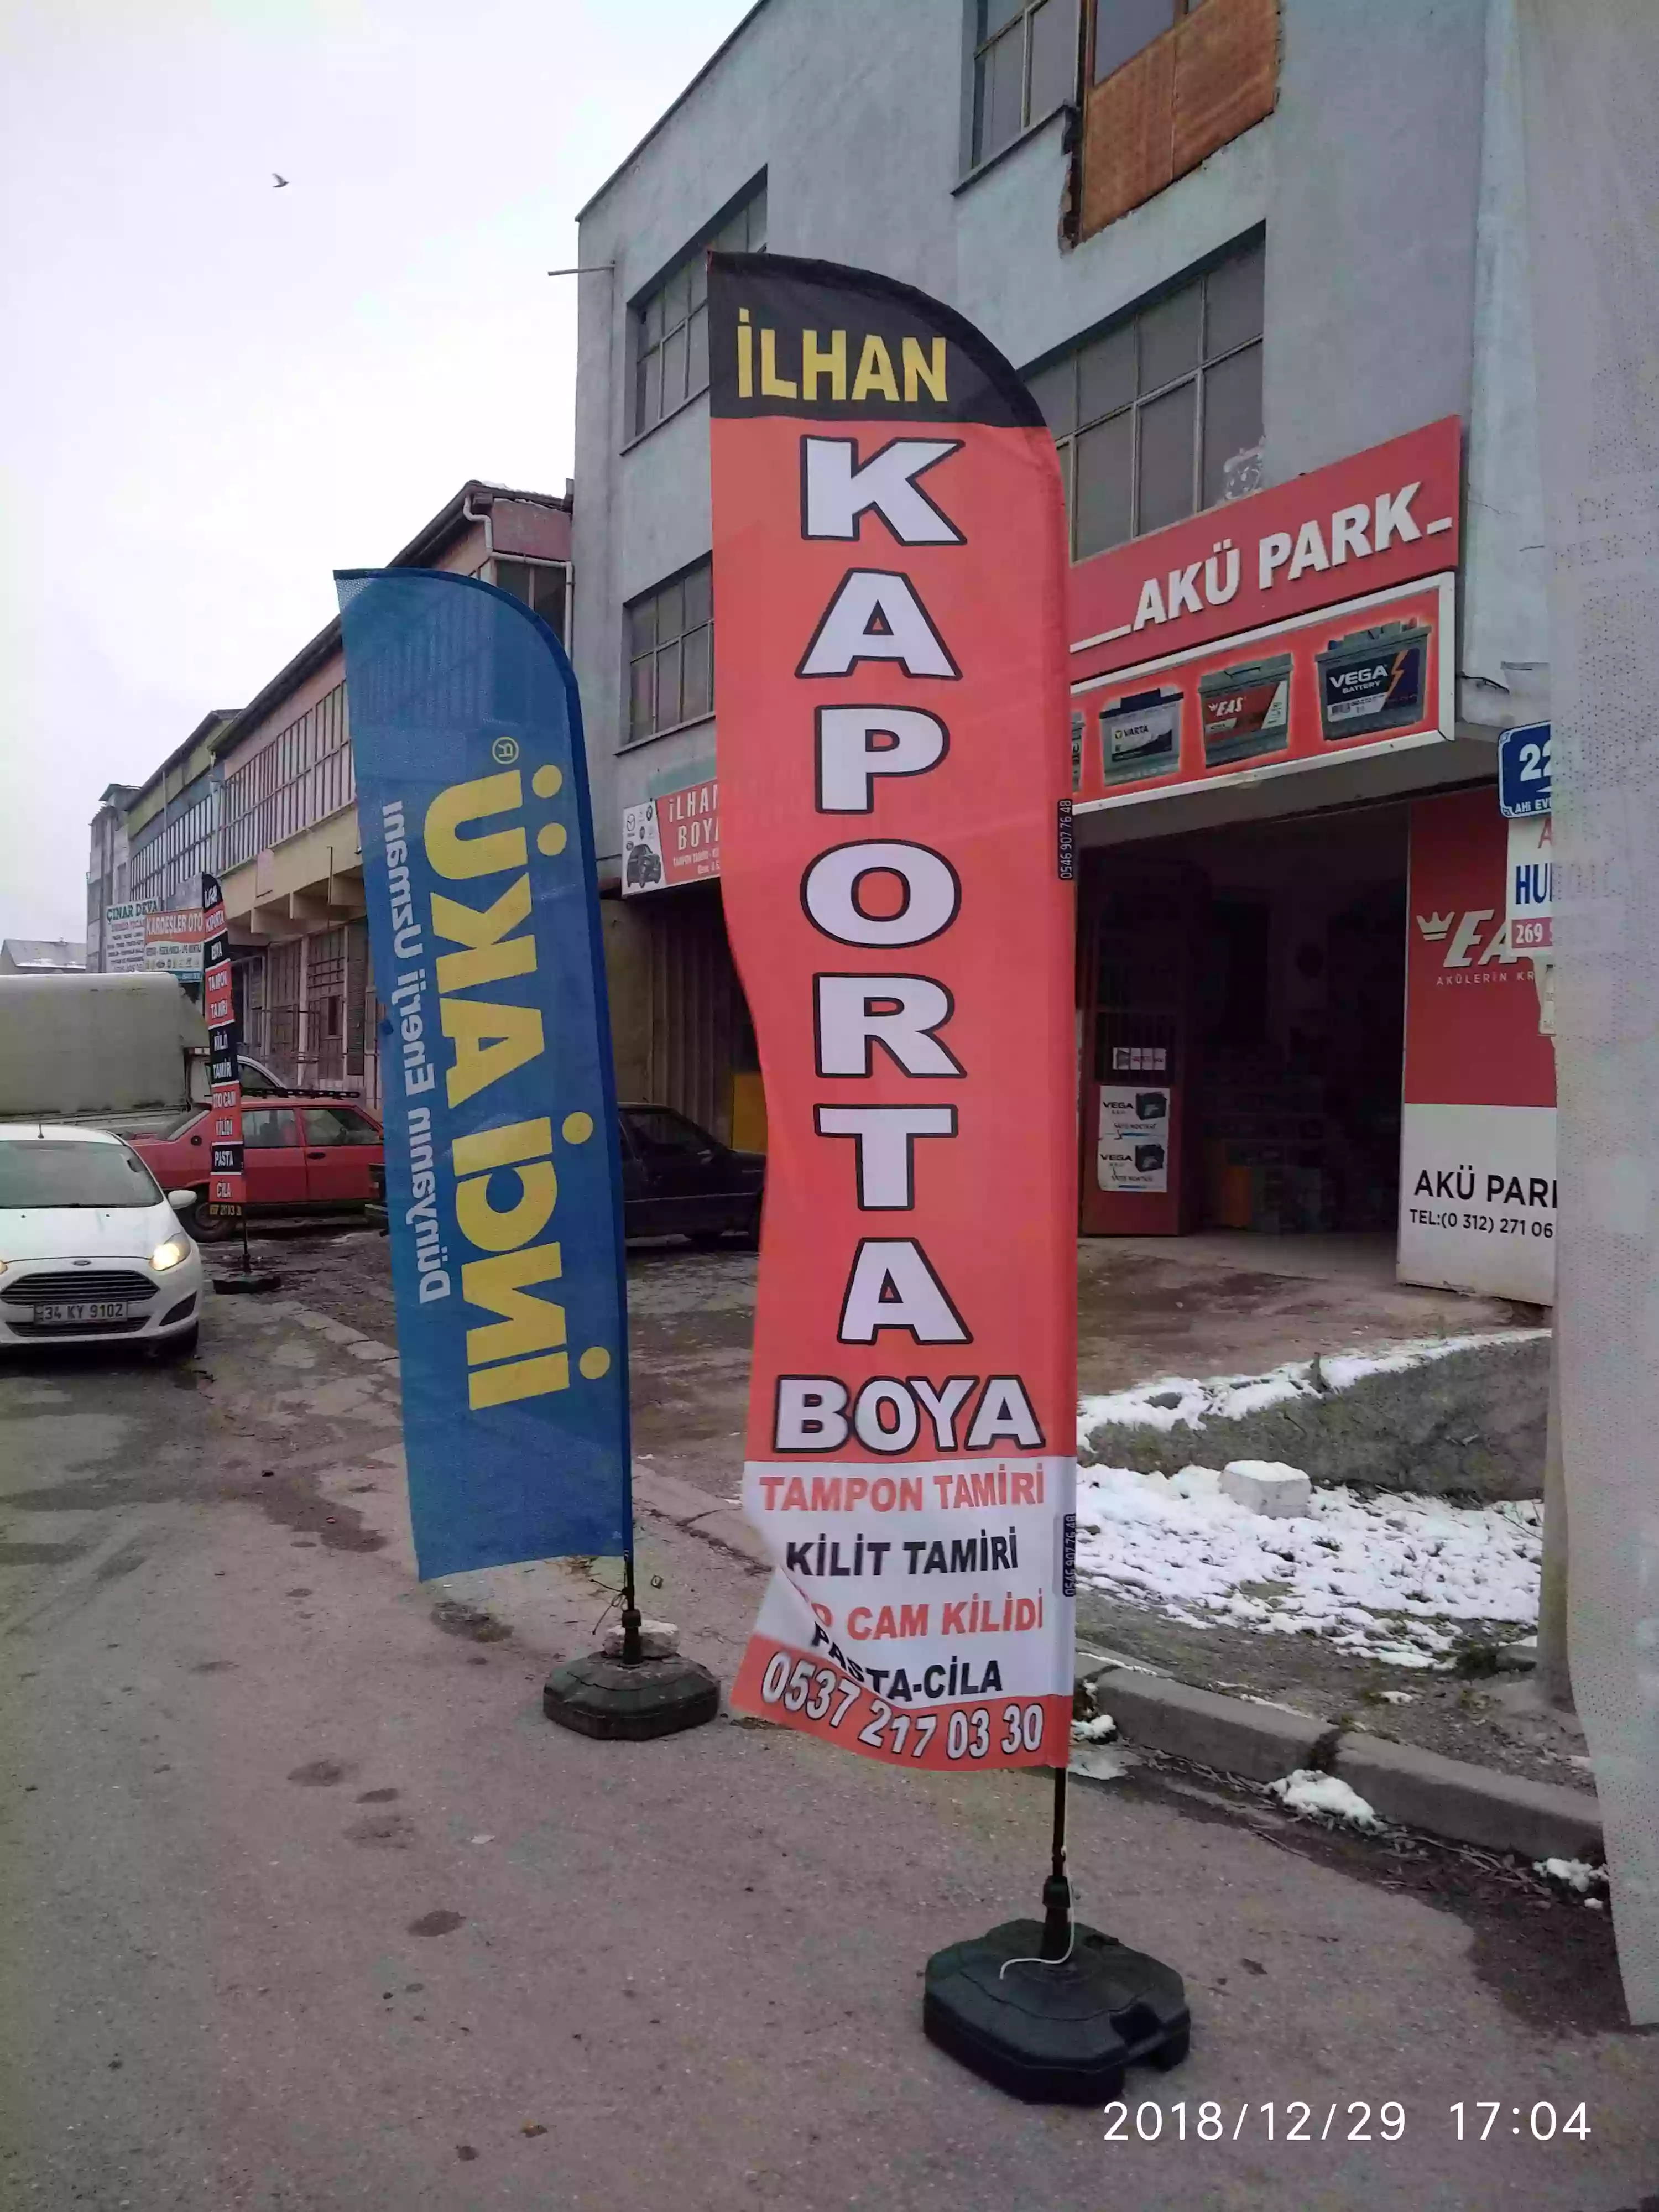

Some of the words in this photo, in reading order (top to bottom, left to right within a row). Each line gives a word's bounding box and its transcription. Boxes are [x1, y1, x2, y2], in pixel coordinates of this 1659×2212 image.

[737, 308, 948, 402] İLHAN
[1133, 539, 1240, 632] AKÜ
[1259, 482, 1423, 589] PARK
[1329, 665, 1389, 688] VEGA
[1343, 680, 1381, 694] BATTERY
[1124, 725, 1149, 737] VARTA
[1060, 800, 1072, 813] 48
[678, 817, 718, 851] BOY
[1060, 816, 1072, 828] 76
[1060, 831, 1072, 850] 907
[1060, 853, 1073, 879] 0546
[795, 435, 972, 1344] KAPORTA
[1516, 862, 1552, 905] HU
[146, 915, 186, 938] KARDEŞLER
[188, 912, 203, 932] OTO
[1516, 923, 1543, 944] 269
[215, 1150, 233, 1166] PASTA
[1413, 1164, 1475, 1200] AKÜ
[1463, 1214, 1494, 1234] 312)
[1499, 1218, 1525, 1235] 271
[1531, 1221, 1554, 1238] 06
[90, 1303, 123, 1318] 9102
[773, 1375, 1046, 1455] BOYA
[760, 1476, 923, 1512] TAMPON
[934, 1463, 1045, 1510] TAMİRİ
[786, 1533, 891, 1576] KİLİT
[902, 1526, 1019, 1575] TAMİRİ
[847, 1604, 929, 1641] CAM
[941, 1588, 1044, 1635] KİLİDİ
[760, 1650, 863, 1729] 0537
[858, 1702, 938, 1759] 217
[946, 1708, 990, 1760] 03
[1000, 1703, 1045, 1753] 30
